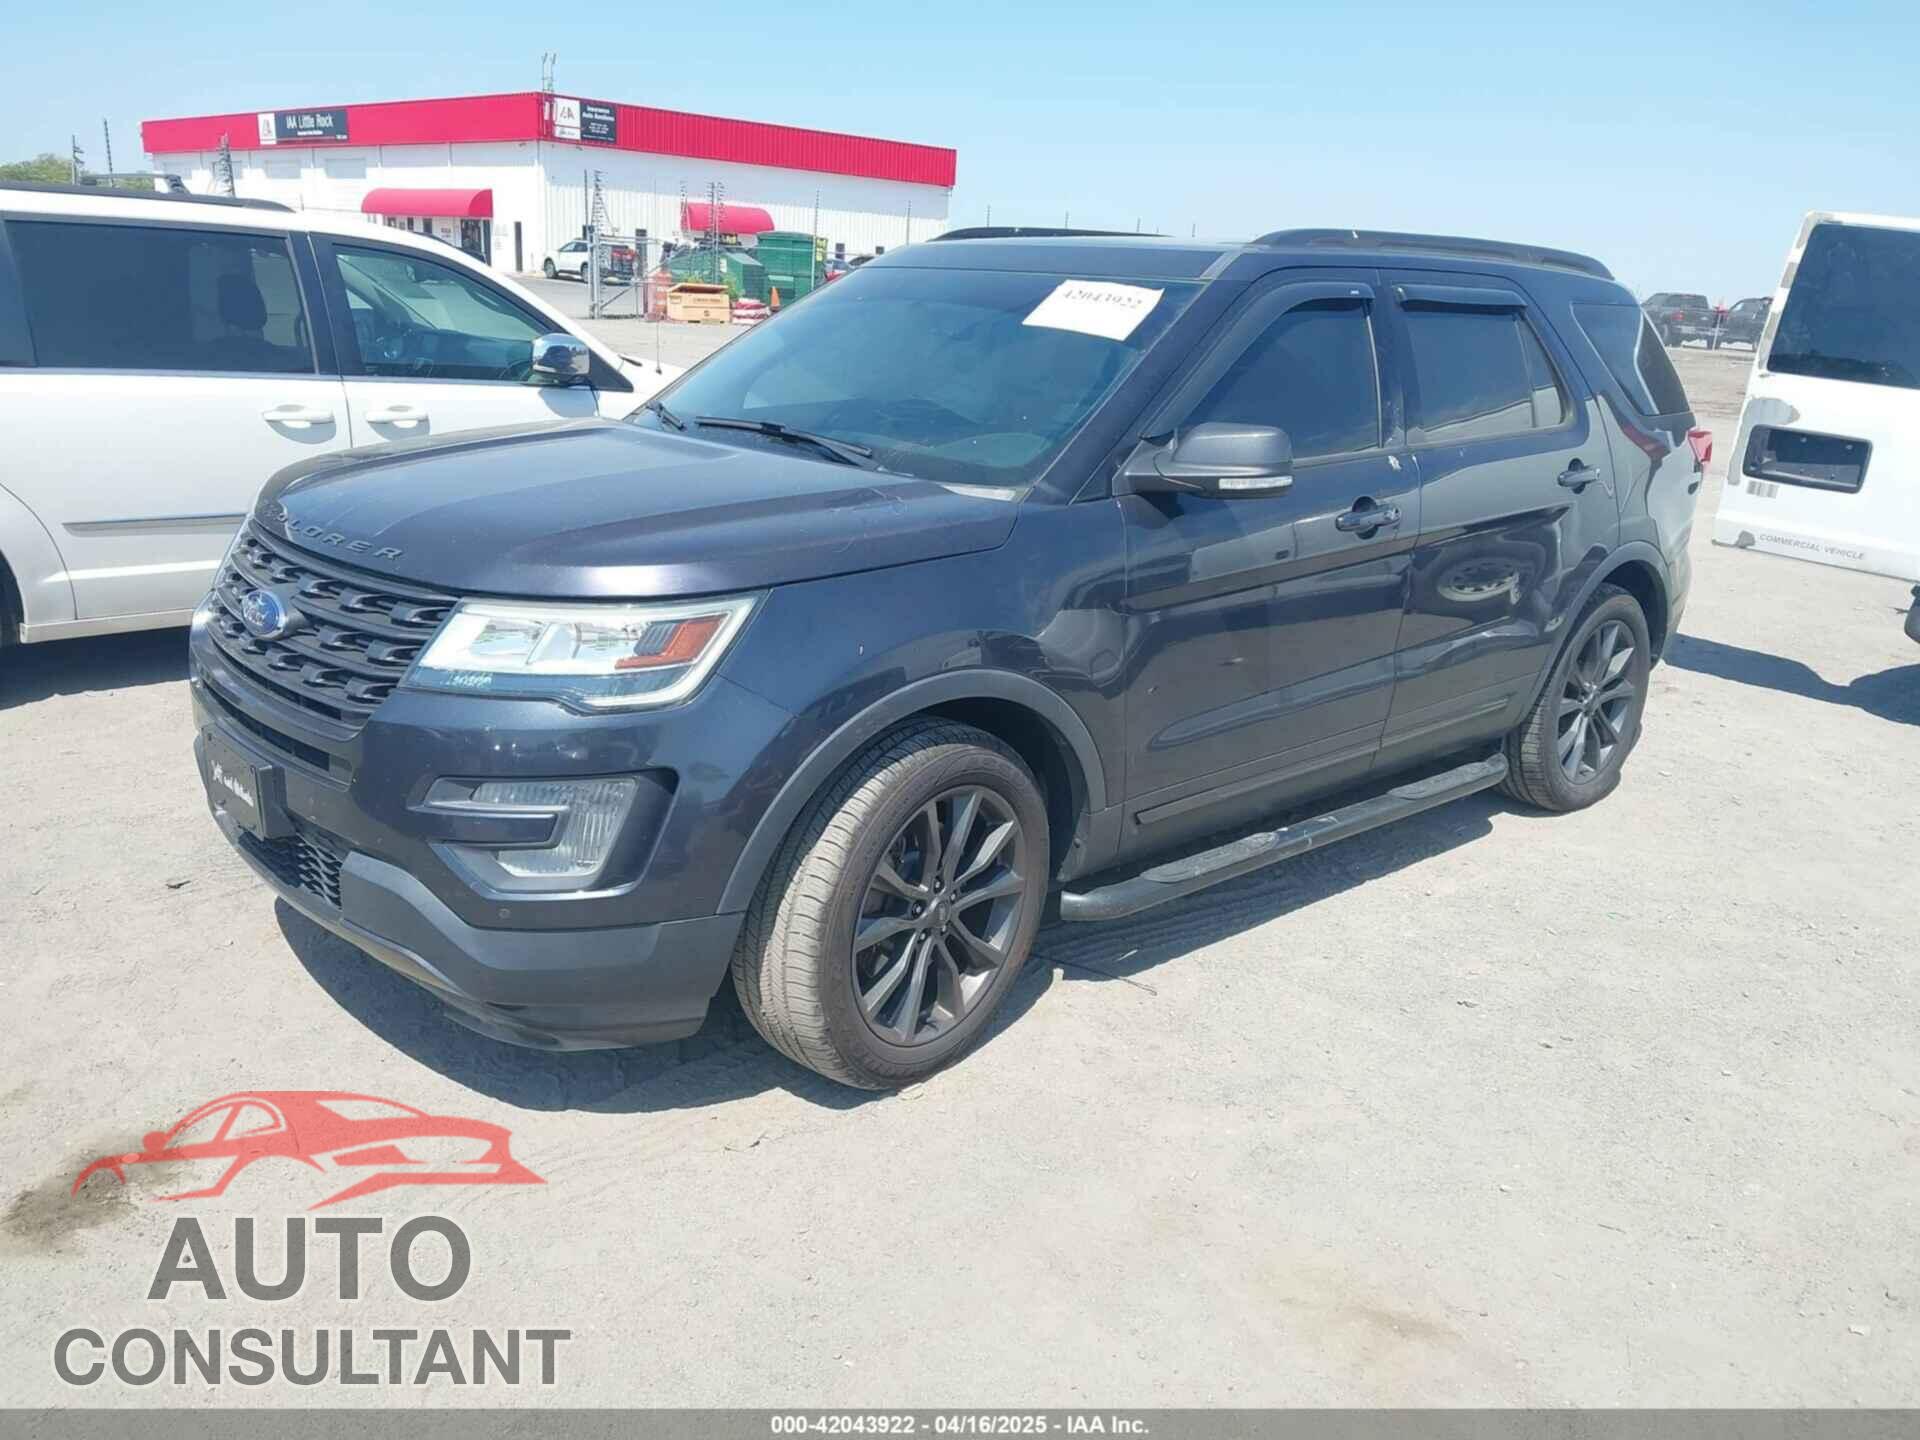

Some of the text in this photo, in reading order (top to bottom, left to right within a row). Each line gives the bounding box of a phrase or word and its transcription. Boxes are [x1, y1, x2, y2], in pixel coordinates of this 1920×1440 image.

[298, 115, 315, 129] Little
[316, 113, 334, 129] Rock
[1759, 534, 1865, 561] COMMERCIAL VEHICLE
